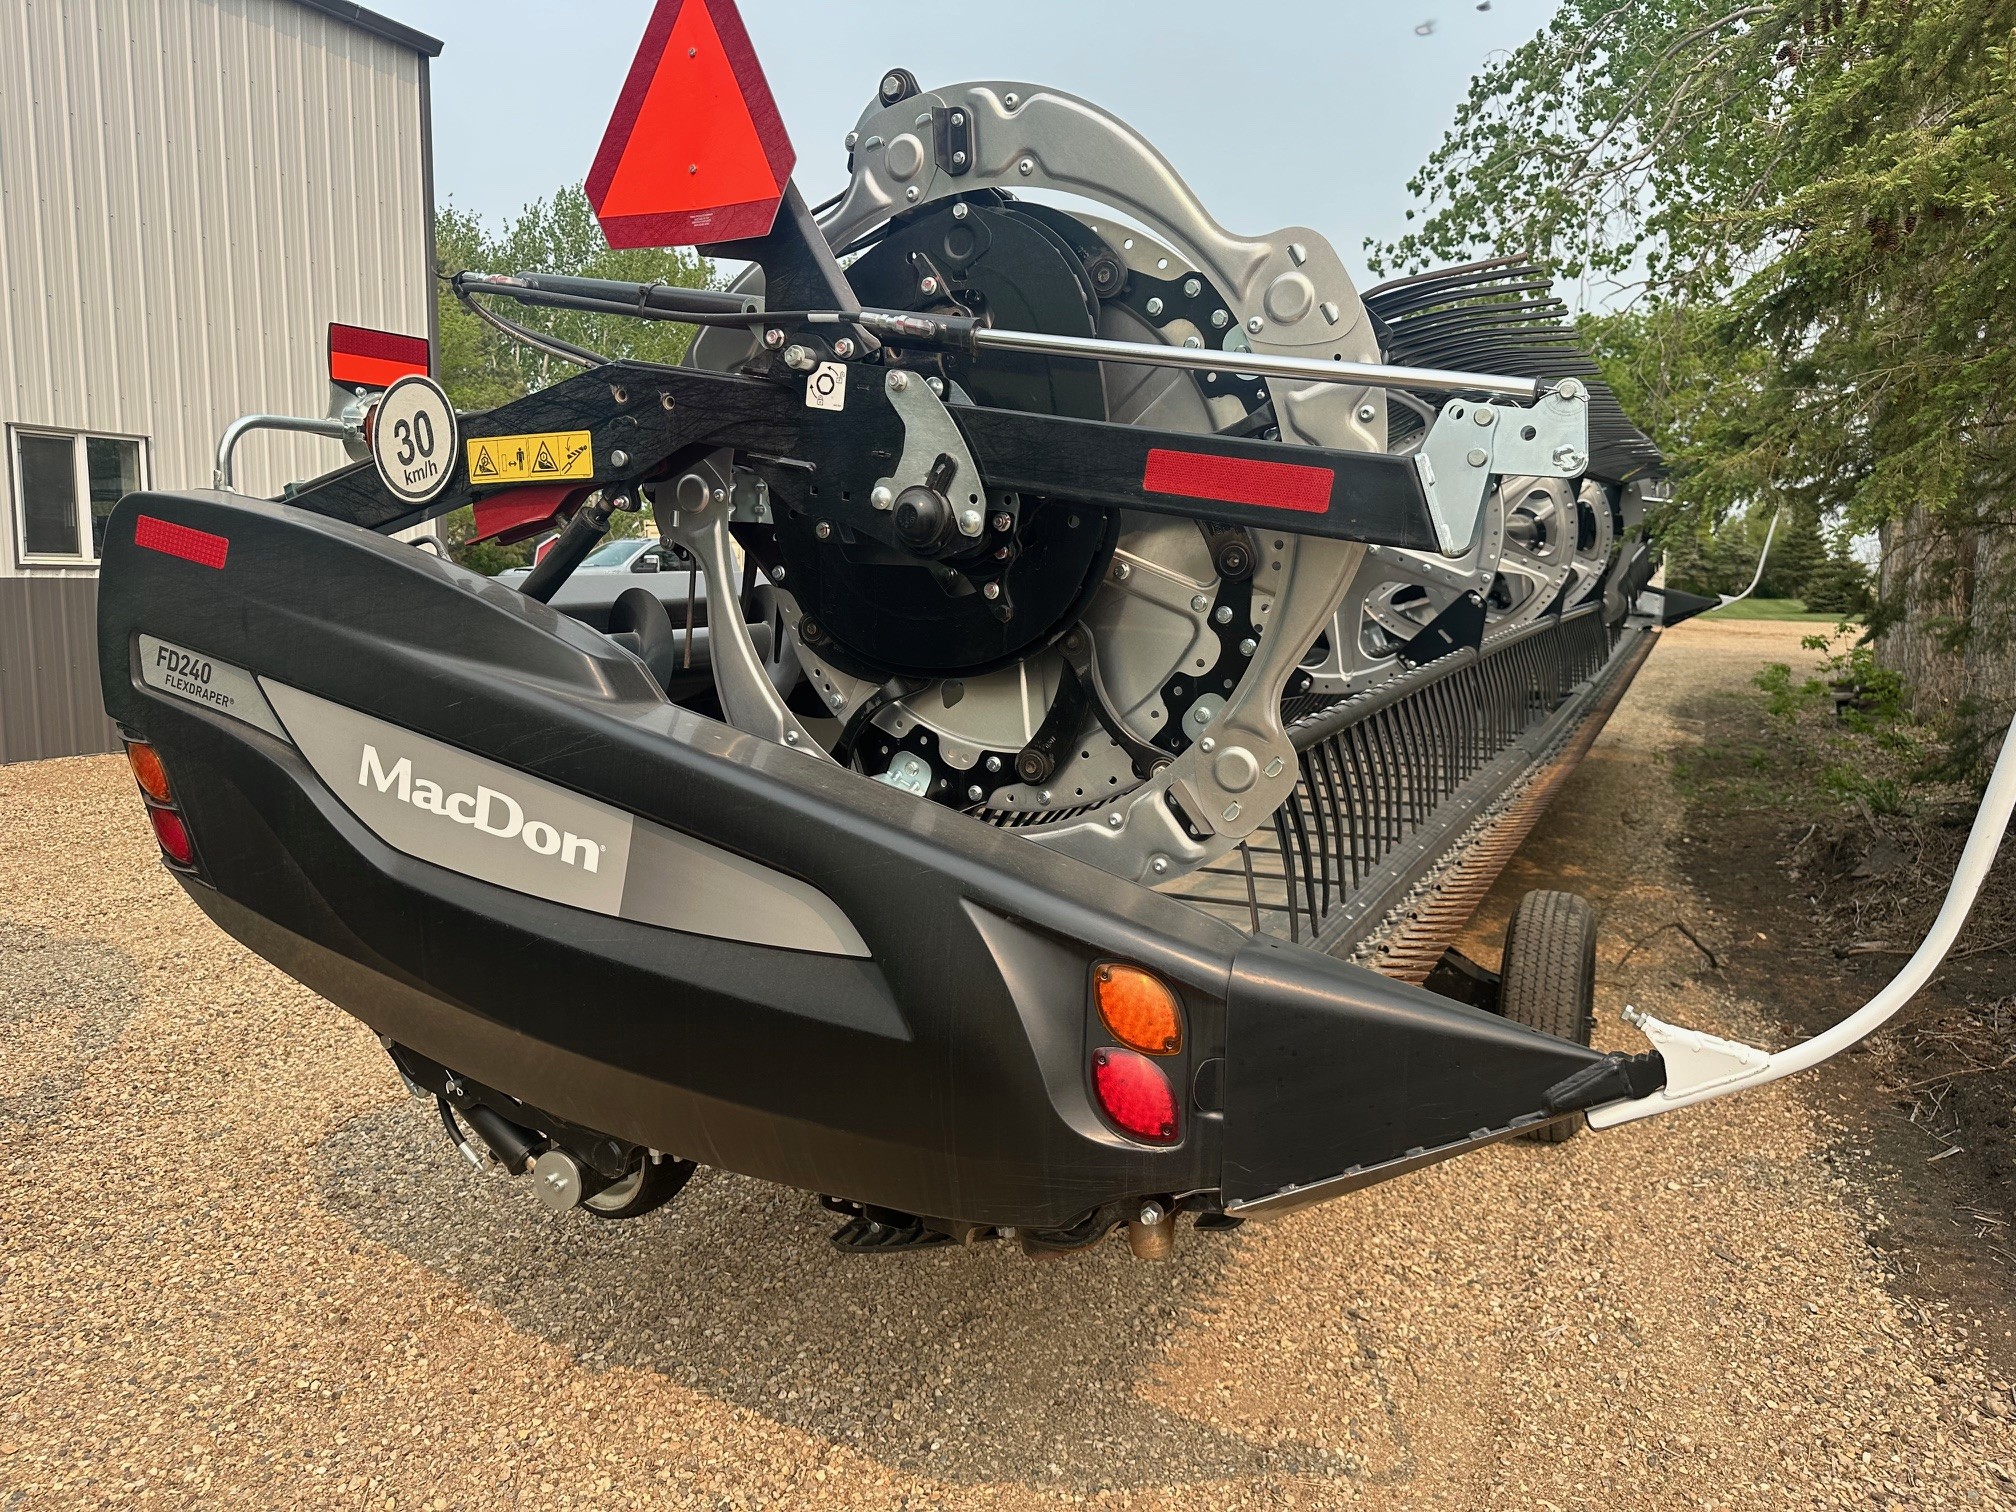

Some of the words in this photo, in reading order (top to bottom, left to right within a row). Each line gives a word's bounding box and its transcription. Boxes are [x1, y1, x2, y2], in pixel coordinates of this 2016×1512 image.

[393, 409, 435, 467] 30
[403, 459, 439, 486] km/h
[156, 645, 212, 685] FD240
